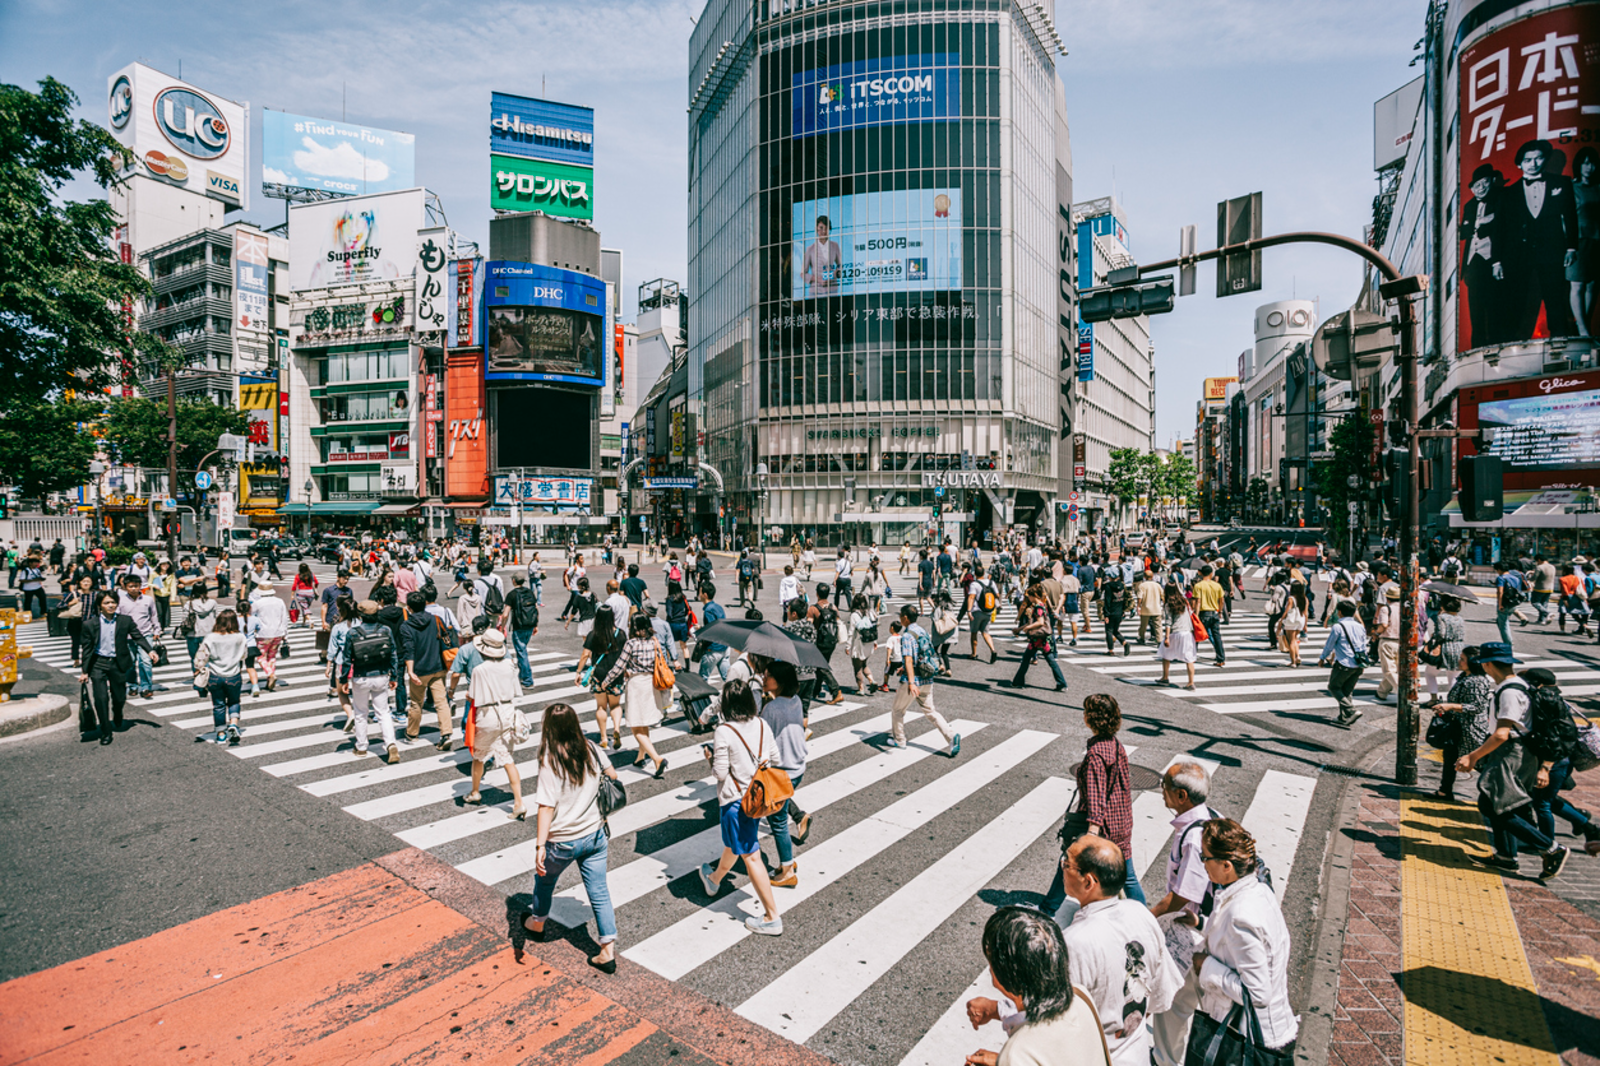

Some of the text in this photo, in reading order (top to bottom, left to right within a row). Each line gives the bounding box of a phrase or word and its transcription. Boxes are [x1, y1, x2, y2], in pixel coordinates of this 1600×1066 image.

[1468, 32, 1580, 114] 日本
[492, 113, 592, 144] Hisamitsu
[146, 153, 188, 176] MasterCard
[210, 176, 239, 195] VISA
[324, 179, 358, 191] crocs
[496, 171, 589, 201] サロンパス
[237, 231, 268, 266] 本
[868, 237, 907, 250] 500円
[327, 246, 382, 263] Superfly
[492, 267, 533, 275] DHC Channel
[419, 239, 446, 328] もんじゃ
[458, 262, 471, 342] 三千里薬品
[534, 286, 563, 300] DHC
[245, 304, 262, 316] まで
[1059, 203, 1072, 441] TSUTAYA
[1539, 378, 1586, 393] Glico
[248, 419, 268, 444] 薬
[391, 433, 409, 447] JTB
[450, 408, 483, 459] クスリ
[808, 426, 940, 440] STARBUCKS COFFEE
[925, 473, 1000, 486] TSUTAYA
[500, 482, 589, 499] 大盛堂書店
